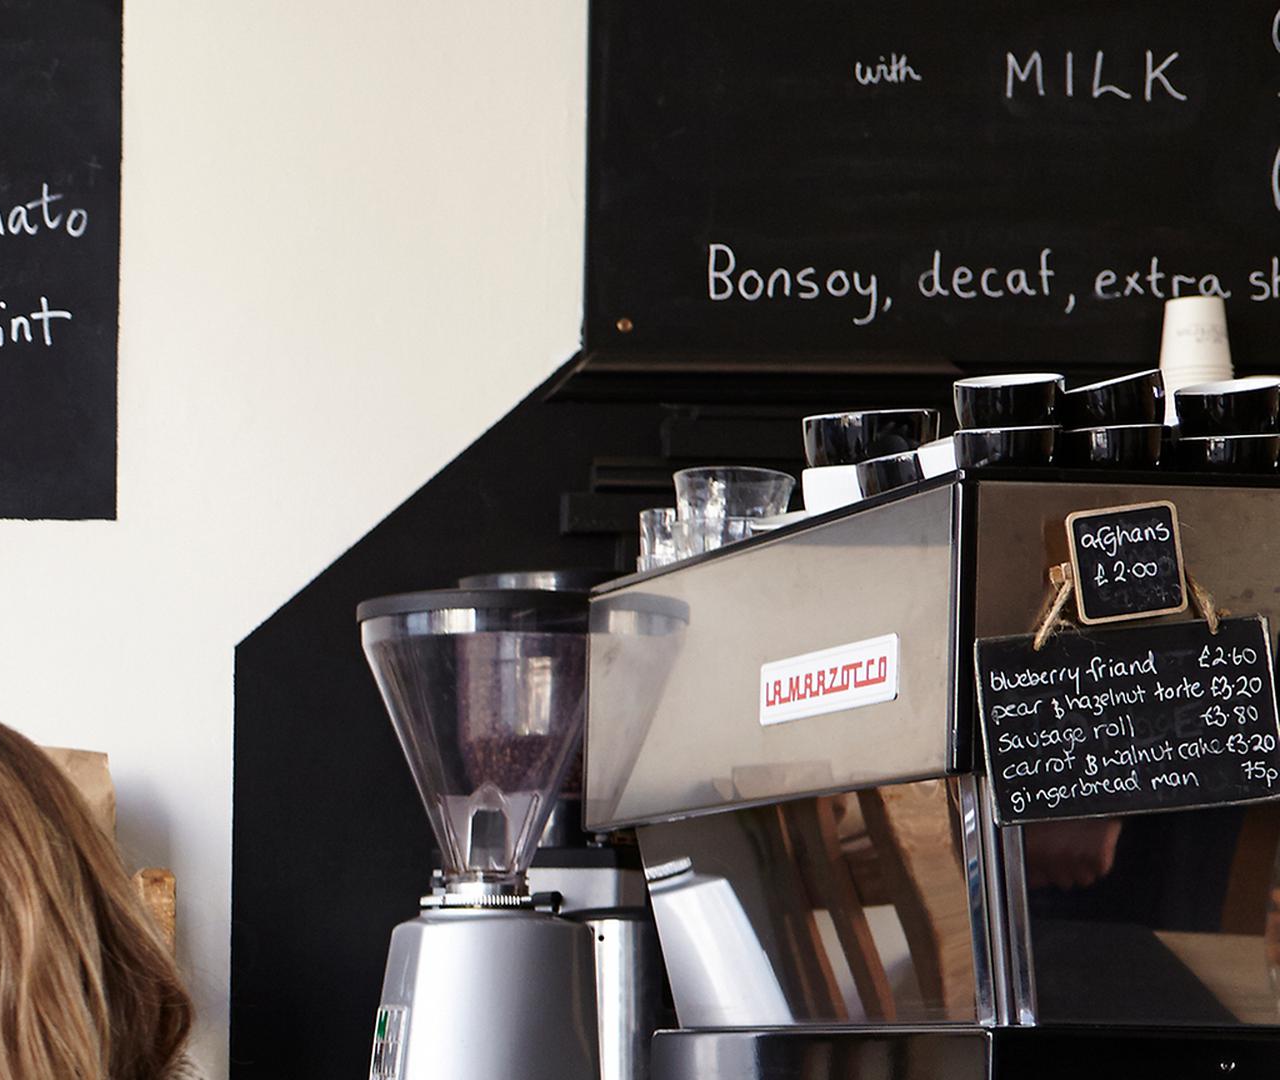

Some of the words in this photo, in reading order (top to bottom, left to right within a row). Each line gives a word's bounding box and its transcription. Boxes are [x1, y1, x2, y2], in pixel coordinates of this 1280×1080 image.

[855, 53, 921, 85] with
[1006, 50, 1188, 101] MILK
[708, 243, 892, 325] Bonsoy,
[918, 248, 1075, 314] decaf,
[1094, 256, 1232, 300] extra
[1080, 522, 1171, 557] afghans
[990, 664, 1080, 695] blueberry
[1085, 650, 1158, 684] friand
[991, 699, 1043, 725] pear
[1066, 684, 1146, 717] hazelnut
[1153, 675, 1205, 702] torte
[998, 726, 1087, 753] sausage
[1093, 714, 1136, 740] roll
[1002, 753, 1077, 780] carrot
[1101, 740, 1174, 768] walnut
[1010, 772, 1141, 813] gingerbread
[1151, 771, 1201, 791] man
[1240, 760, 1279, 788] 75p
